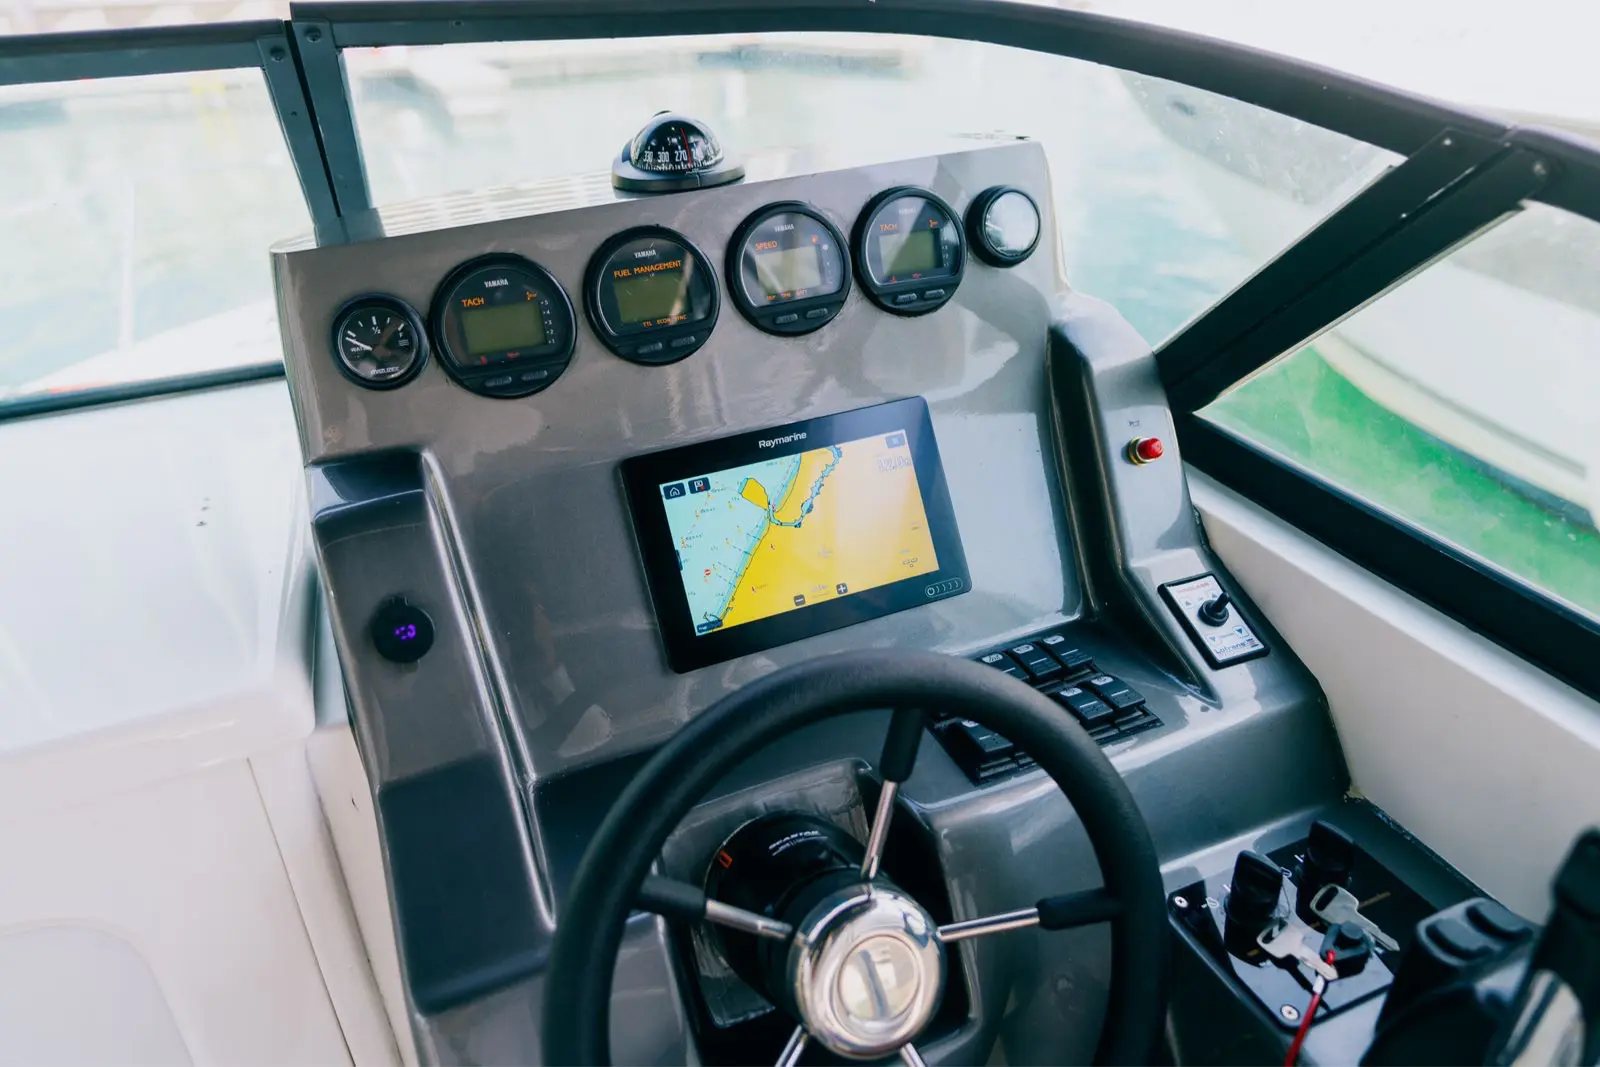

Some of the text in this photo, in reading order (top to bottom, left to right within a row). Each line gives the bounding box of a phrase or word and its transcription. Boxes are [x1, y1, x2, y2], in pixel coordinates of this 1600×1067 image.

[657, 151, 670, 163] 300
[674, 149, 688, 162] 270
[755, 240, 778, 251] SPEED
[634, 249, 657, 259] YAMAHA
[613, 260, 682, 279] FUEL MANAGEMENT
[484, 278, 509, 288] YAMAHA
[461, 296, 485, 308] TACH
[758, 432, 807, 449] Raymarine
